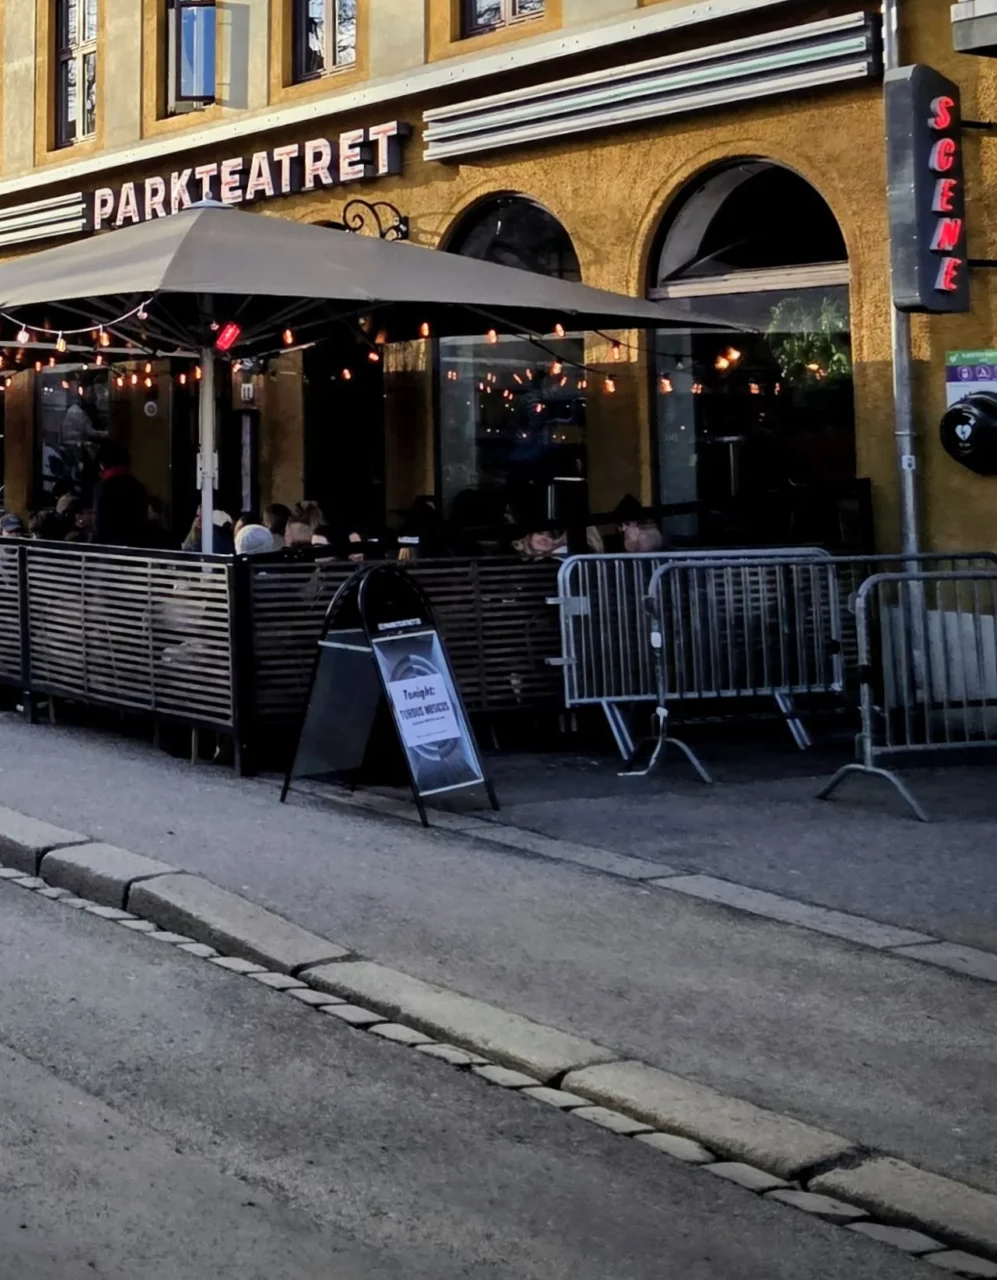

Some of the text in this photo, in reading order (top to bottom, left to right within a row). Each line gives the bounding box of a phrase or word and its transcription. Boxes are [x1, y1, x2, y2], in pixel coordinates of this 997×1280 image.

[93, 120, 399, 230] PARKTEATRET
[928, 96, 961, 291] SCENE
[403, 686, 436, 701] Tonight:
